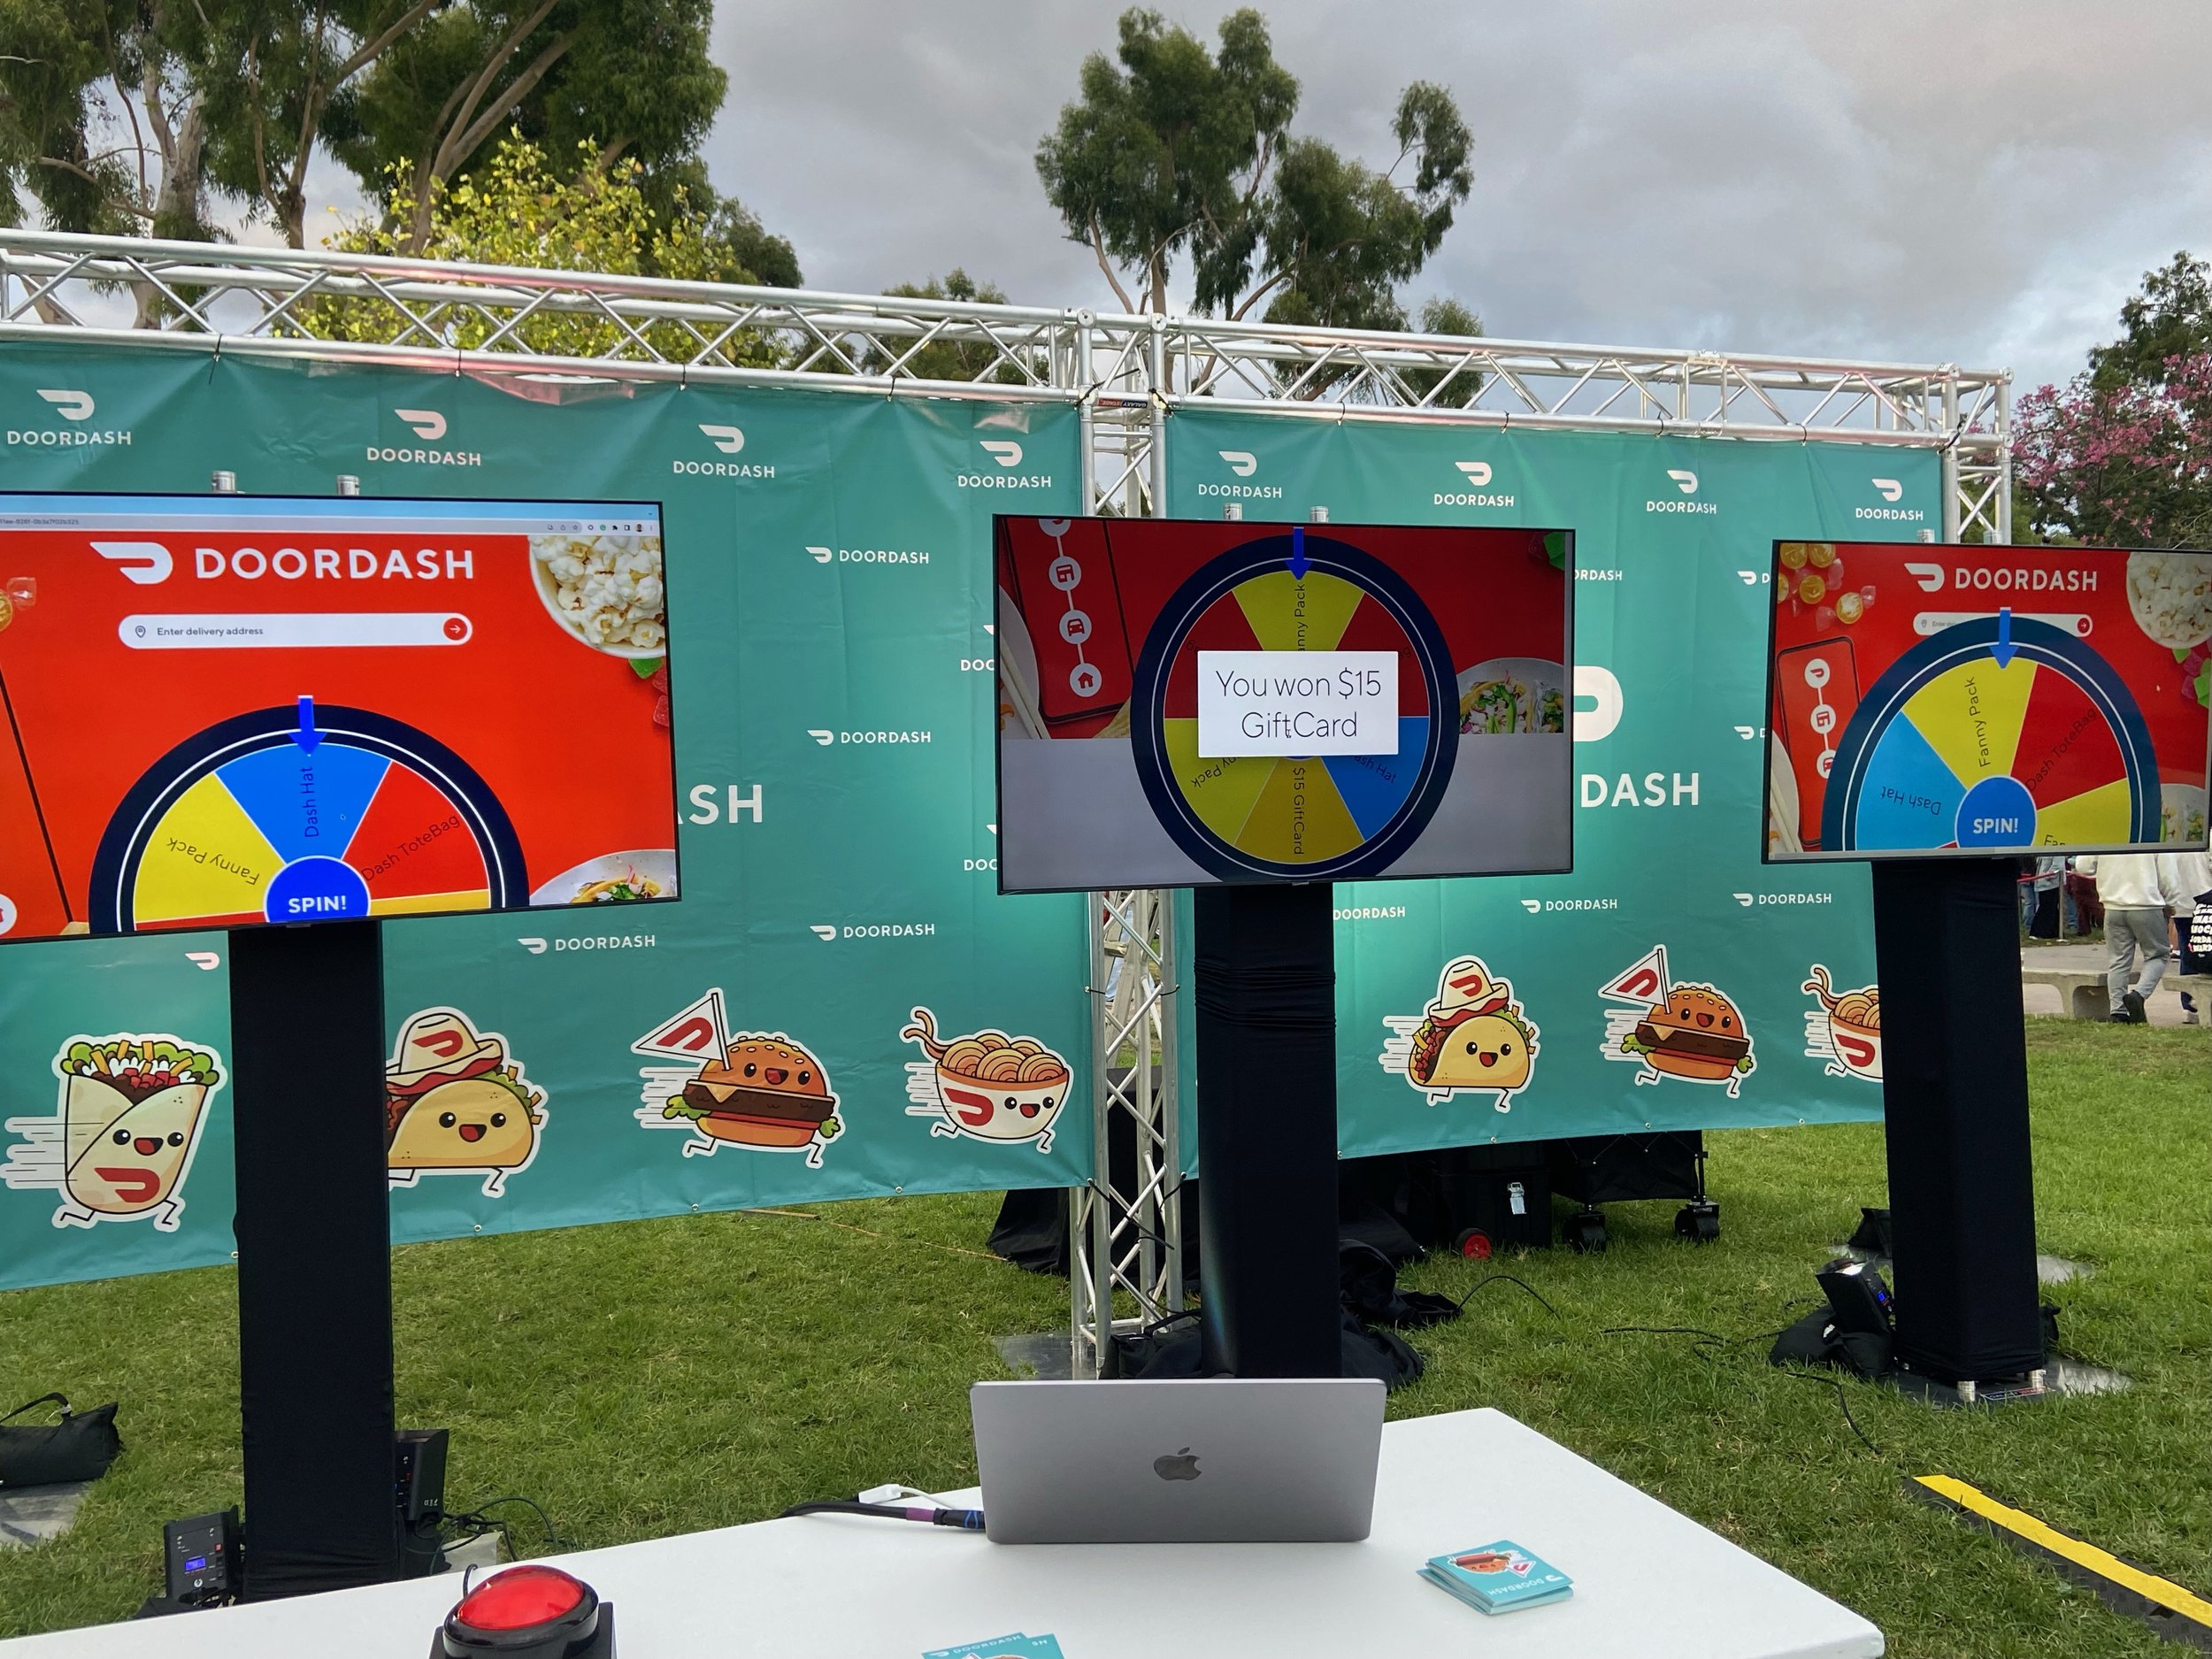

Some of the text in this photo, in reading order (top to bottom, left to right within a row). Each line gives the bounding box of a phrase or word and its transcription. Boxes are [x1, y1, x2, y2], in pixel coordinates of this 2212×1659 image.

[7, 430, 131, 447] DOORDASH
[366, 446, 481, 467] DOORDASH
[674, 460, 776, 479] DOORDASH
[958, 475, 1051, 488] DOORDASH
[1198, 483, 1282, 498] DOORDASH
[1433, 494, 1514, 507] DOORDASH
[1647, 501, 1717, 514] DOORDASH
[1855, 508, 1924, 521] DOORDASH
[195, 548, 474, 580] DOORDASH
[839, 549, 929, 565] DOORDASH
[1955, 567, 2097, 591] DOORDASH
[1294, 584, 1305, 617] Pack
[157, 626, 264, 637] Enter delivery address
[1216, 667, 1381, 700] You won $15
[1241, 710, 1357, 739] GiftCard
[1964, 677, 1991, 767] Fanny Pack
[841, 731, 931, 744] DOORDASH
[2025, 707, 2097, 792] Dash ToteBag
[1191, 764, 1222, 787] Pack
[1375, 764, 1396, 784] Hat
[1580, 772, 1699, 808] DASH
[300, 766, 319, 837] Dash Hat
[1880, 785, 1941, 816] Dash Hat
[1292, 767, 1305, 855] $15 GiftCard
[1972, 818, 2018, 833] SPIN!
[360, 814, 461, 881] Dash ToteBag
[166, 837, 260, 885] Fanny Pack
[288, 895, 347, 913] SPIN!
[1546, 898, 1617, 911] DOORDASH
[1758, 893, 1832, 905] DOORDASH
[1333, 906, 1406, 921] DOORDASH
[844, 923, 935, 939] DOORDASH
[556, 934, 656, 951] DOORDASH
[1487, 1578, 1545, 1596] DOORDASH
[953, 1634, 1021, 1654] DOORDASH
